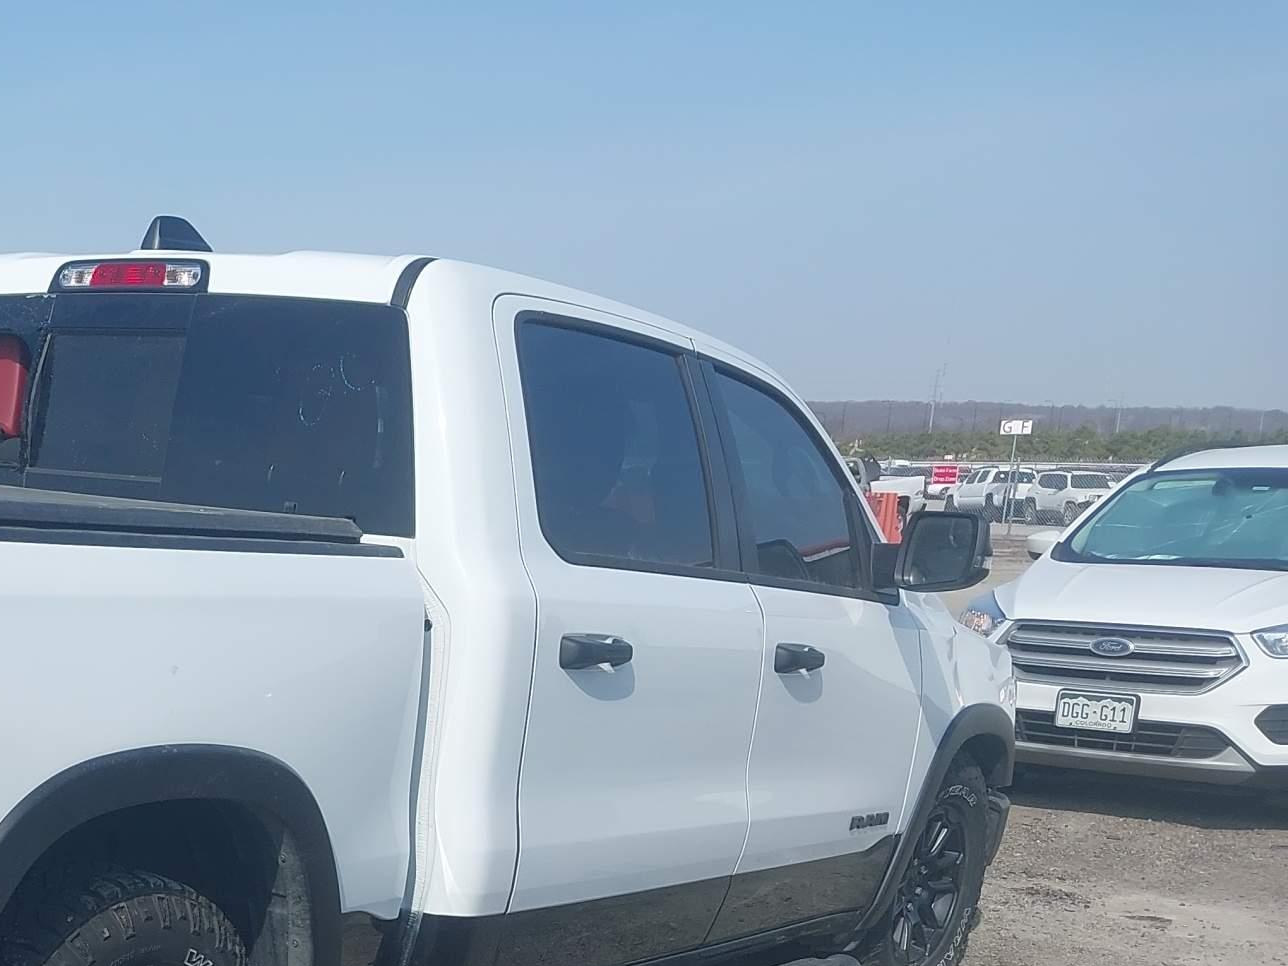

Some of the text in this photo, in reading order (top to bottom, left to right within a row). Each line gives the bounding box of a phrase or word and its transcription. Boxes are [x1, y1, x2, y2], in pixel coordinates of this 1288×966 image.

[1003, 420, 1030, 433] G F
[849, 811, 890, 832] RAM
